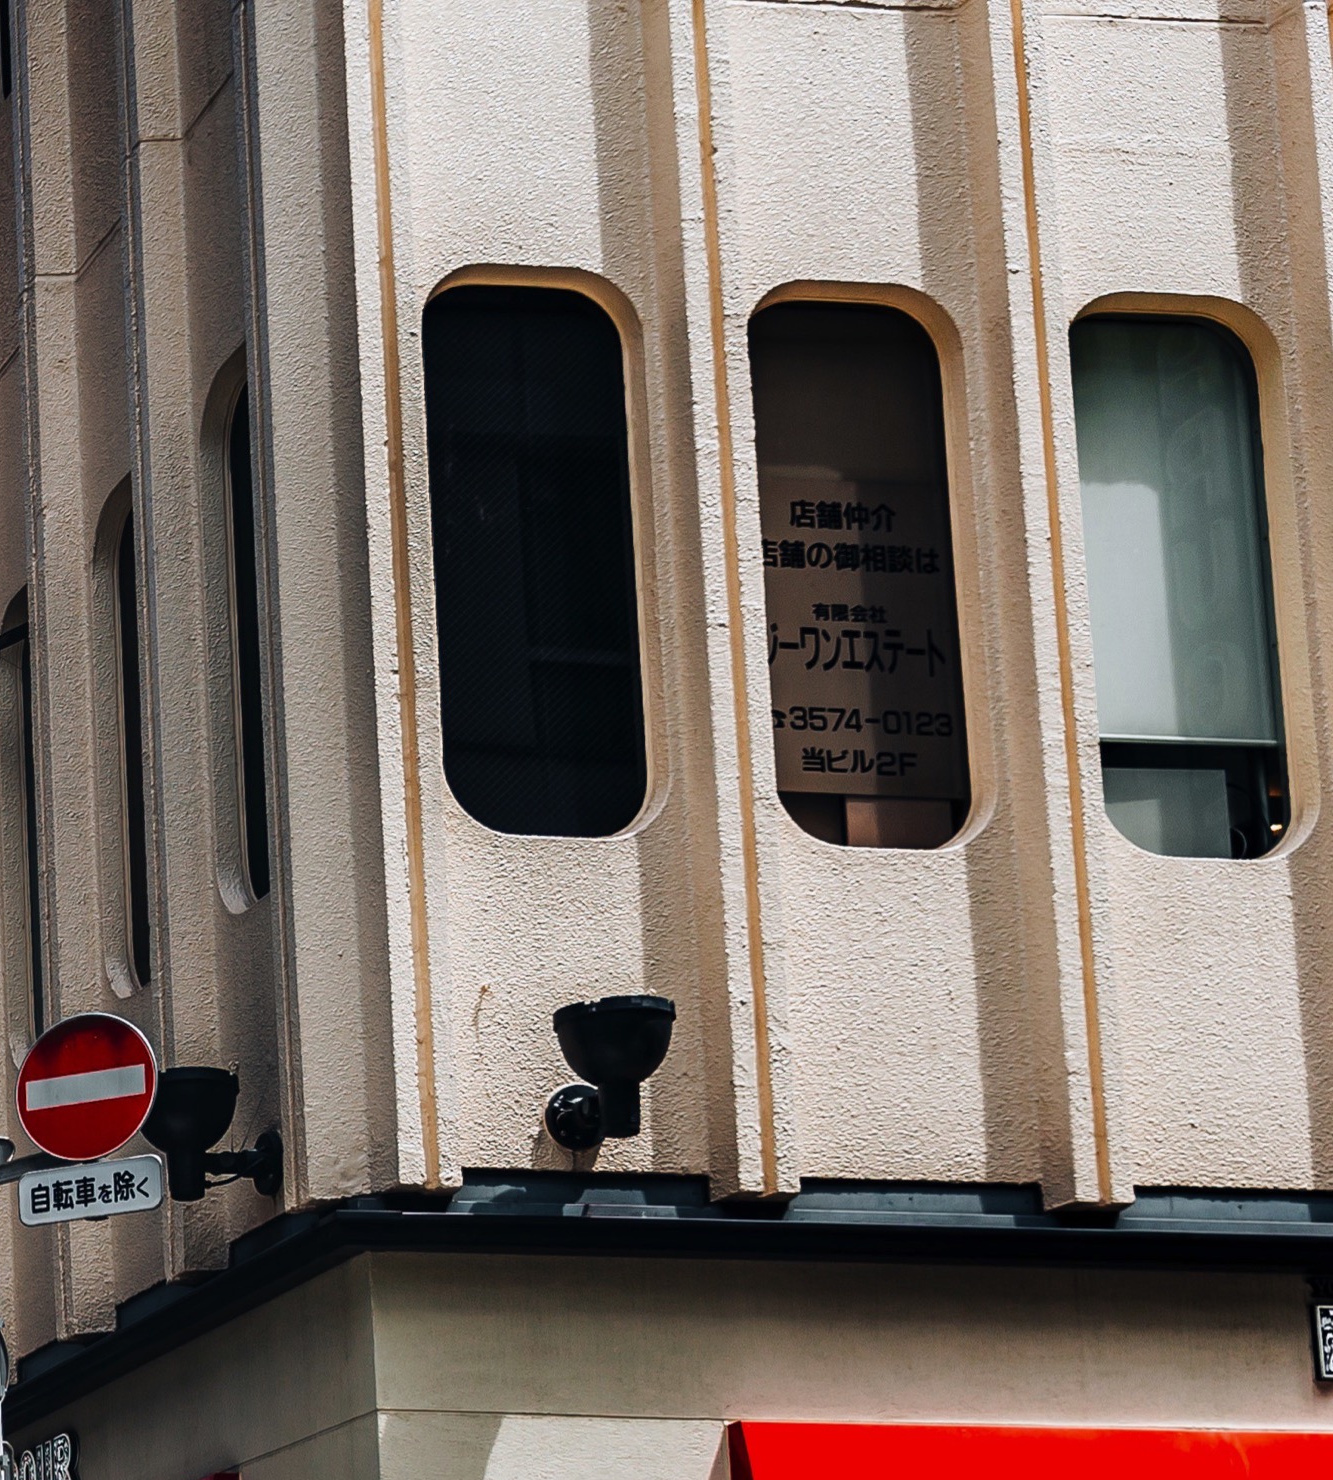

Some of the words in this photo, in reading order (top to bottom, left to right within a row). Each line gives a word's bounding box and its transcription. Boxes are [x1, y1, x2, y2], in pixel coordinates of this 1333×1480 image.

[789, 499, 896, 532] 店舗仲介
[811, 601, 887, 625] 有限会社
[801, 746, 918, 777] 当ビル2F
[30, 1169, 150, 1215] 自転車を除く
